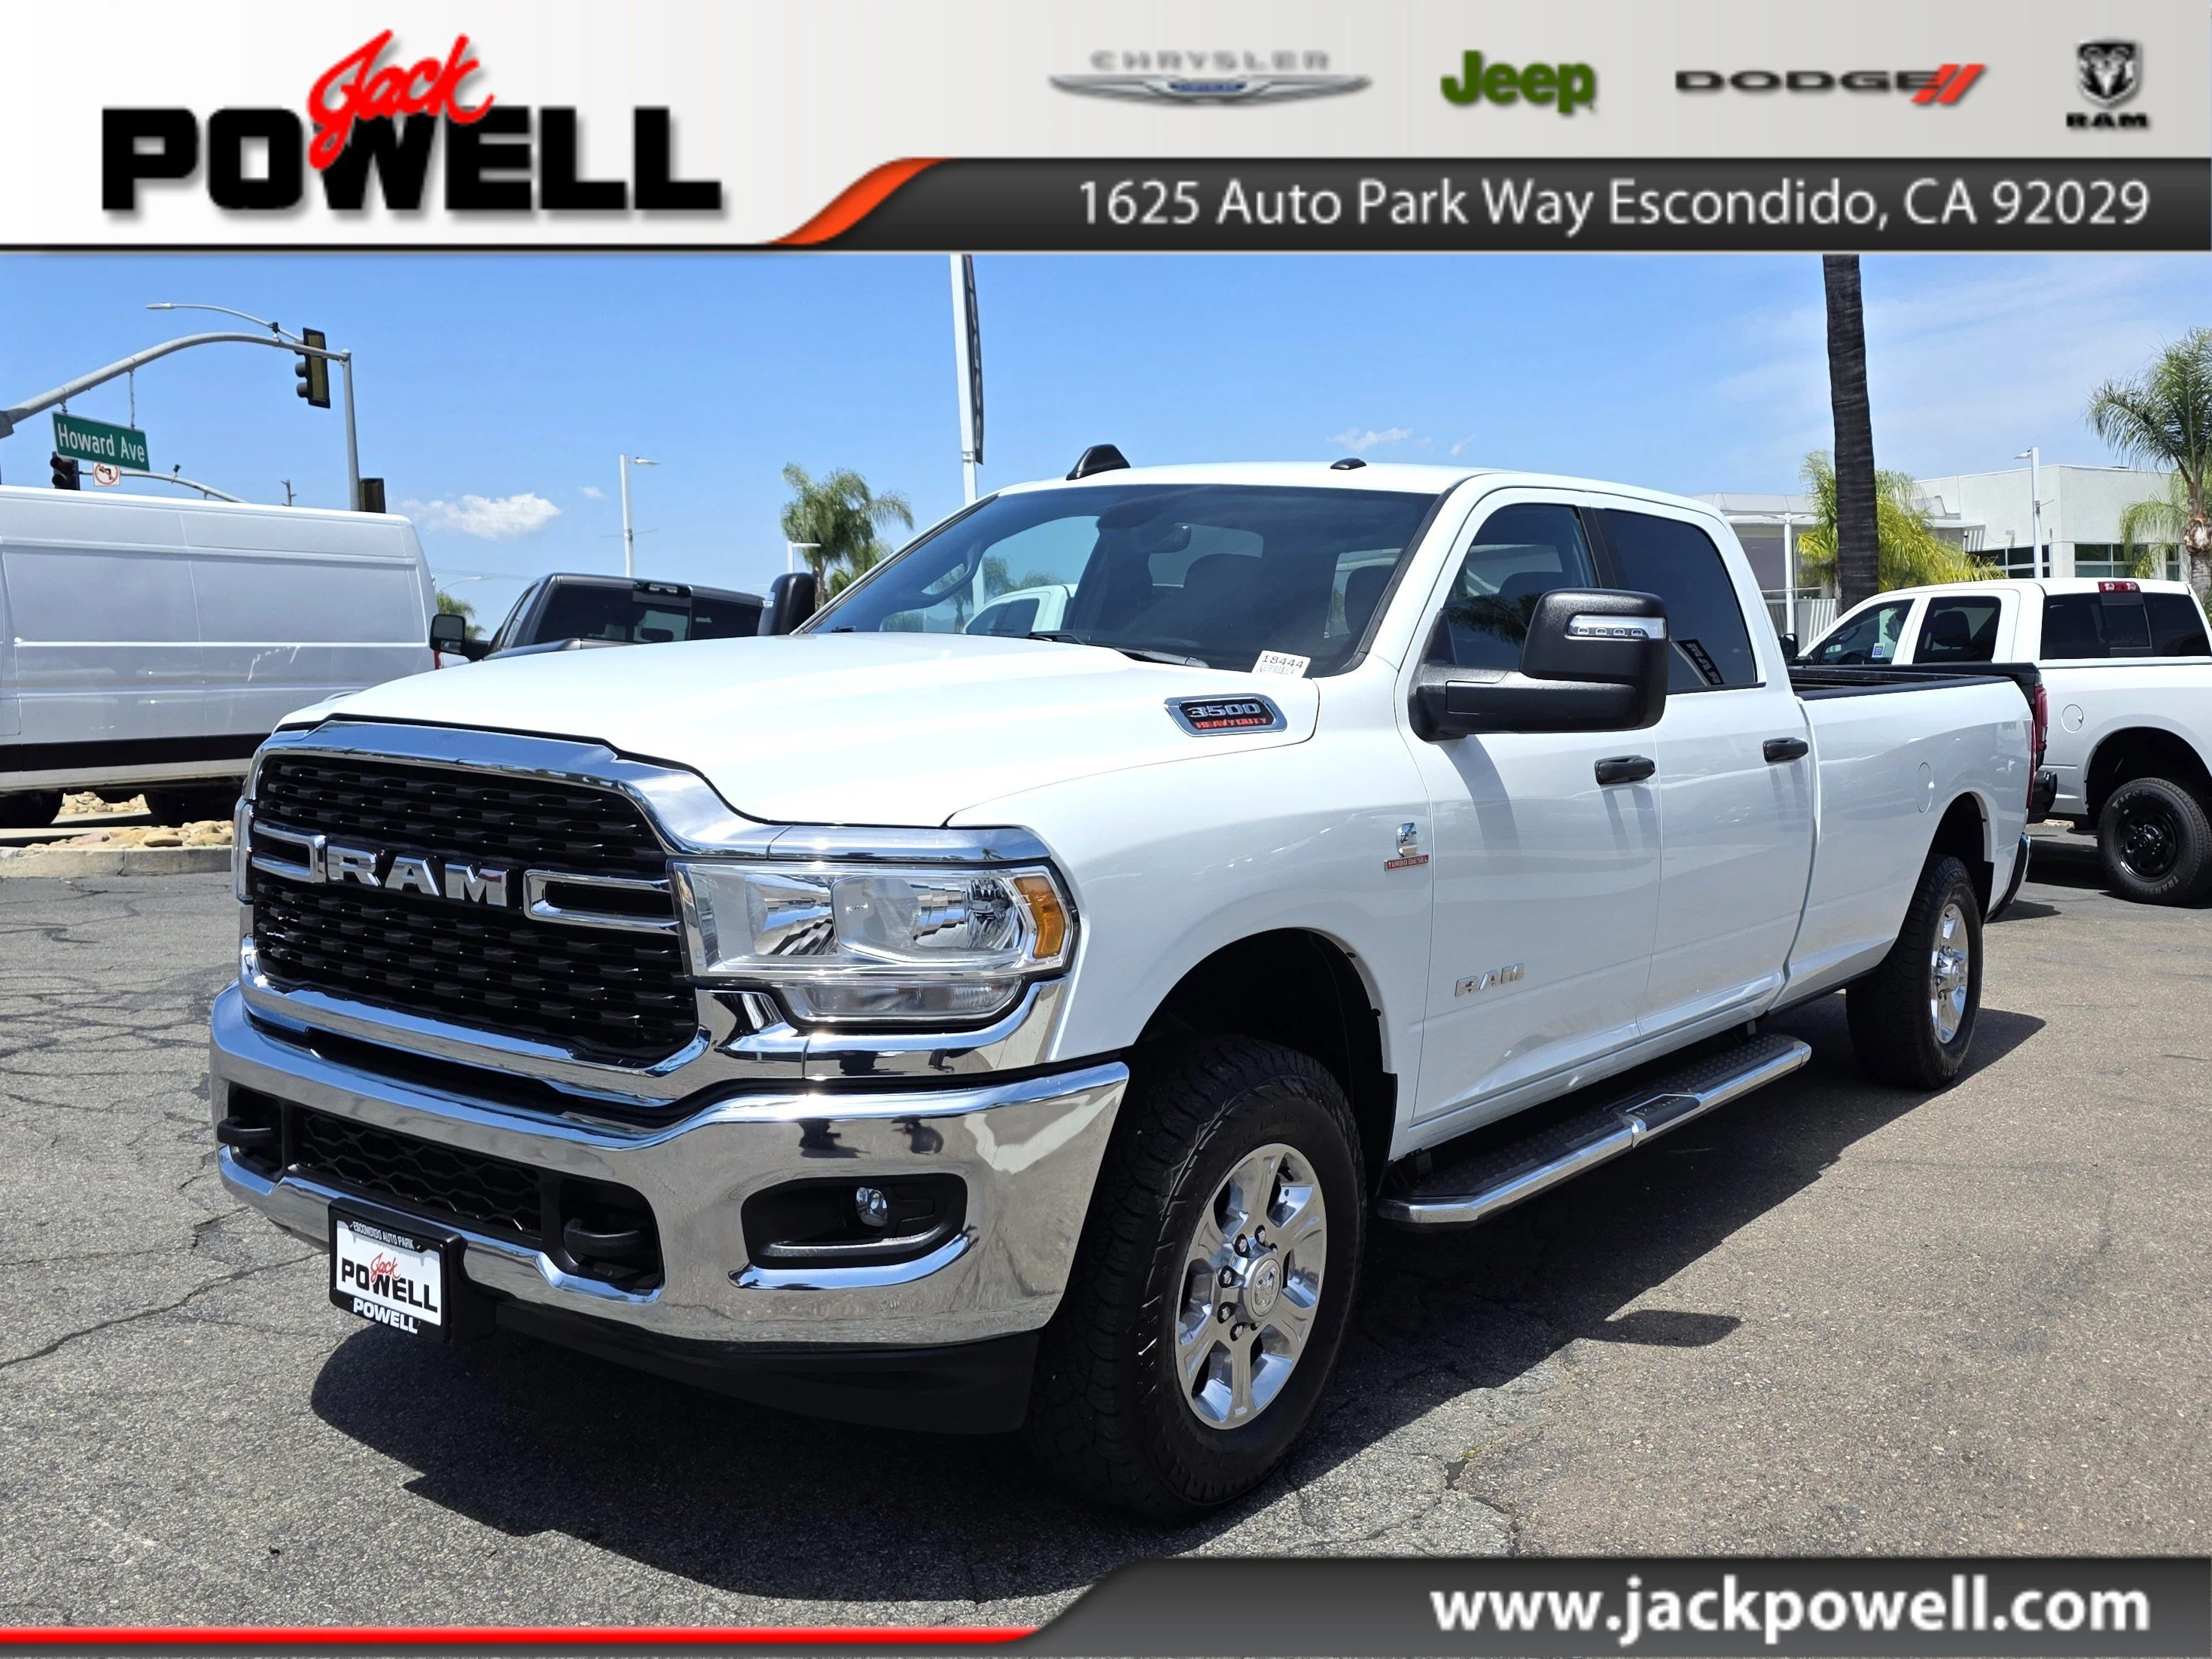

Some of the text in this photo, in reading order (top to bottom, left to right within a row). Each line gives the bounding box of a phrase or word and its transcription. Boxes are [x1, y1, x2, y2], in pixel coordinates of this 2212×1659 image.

[57, 422, 145, 462] Howard Ave
[1262, 654, 1304, 669] 18444
[1187, 703, 1262, 718] 3500
[1195, 718, 1235, 728] HEAVY
[327, 845, 508, 907] RAM
[1388, 856, 1428, 868] TURBO DIESEL
[1455, 962, 1525, 996] RAM
[382, 1231, 398, 1245] AUTO
[397, 1235, 415, 1250] PARK
[370, 1252, 401, 1283] Jack
[341, 1257, 438, 1313] POWELL
[353, 1297, 419, 1334] POWELL
